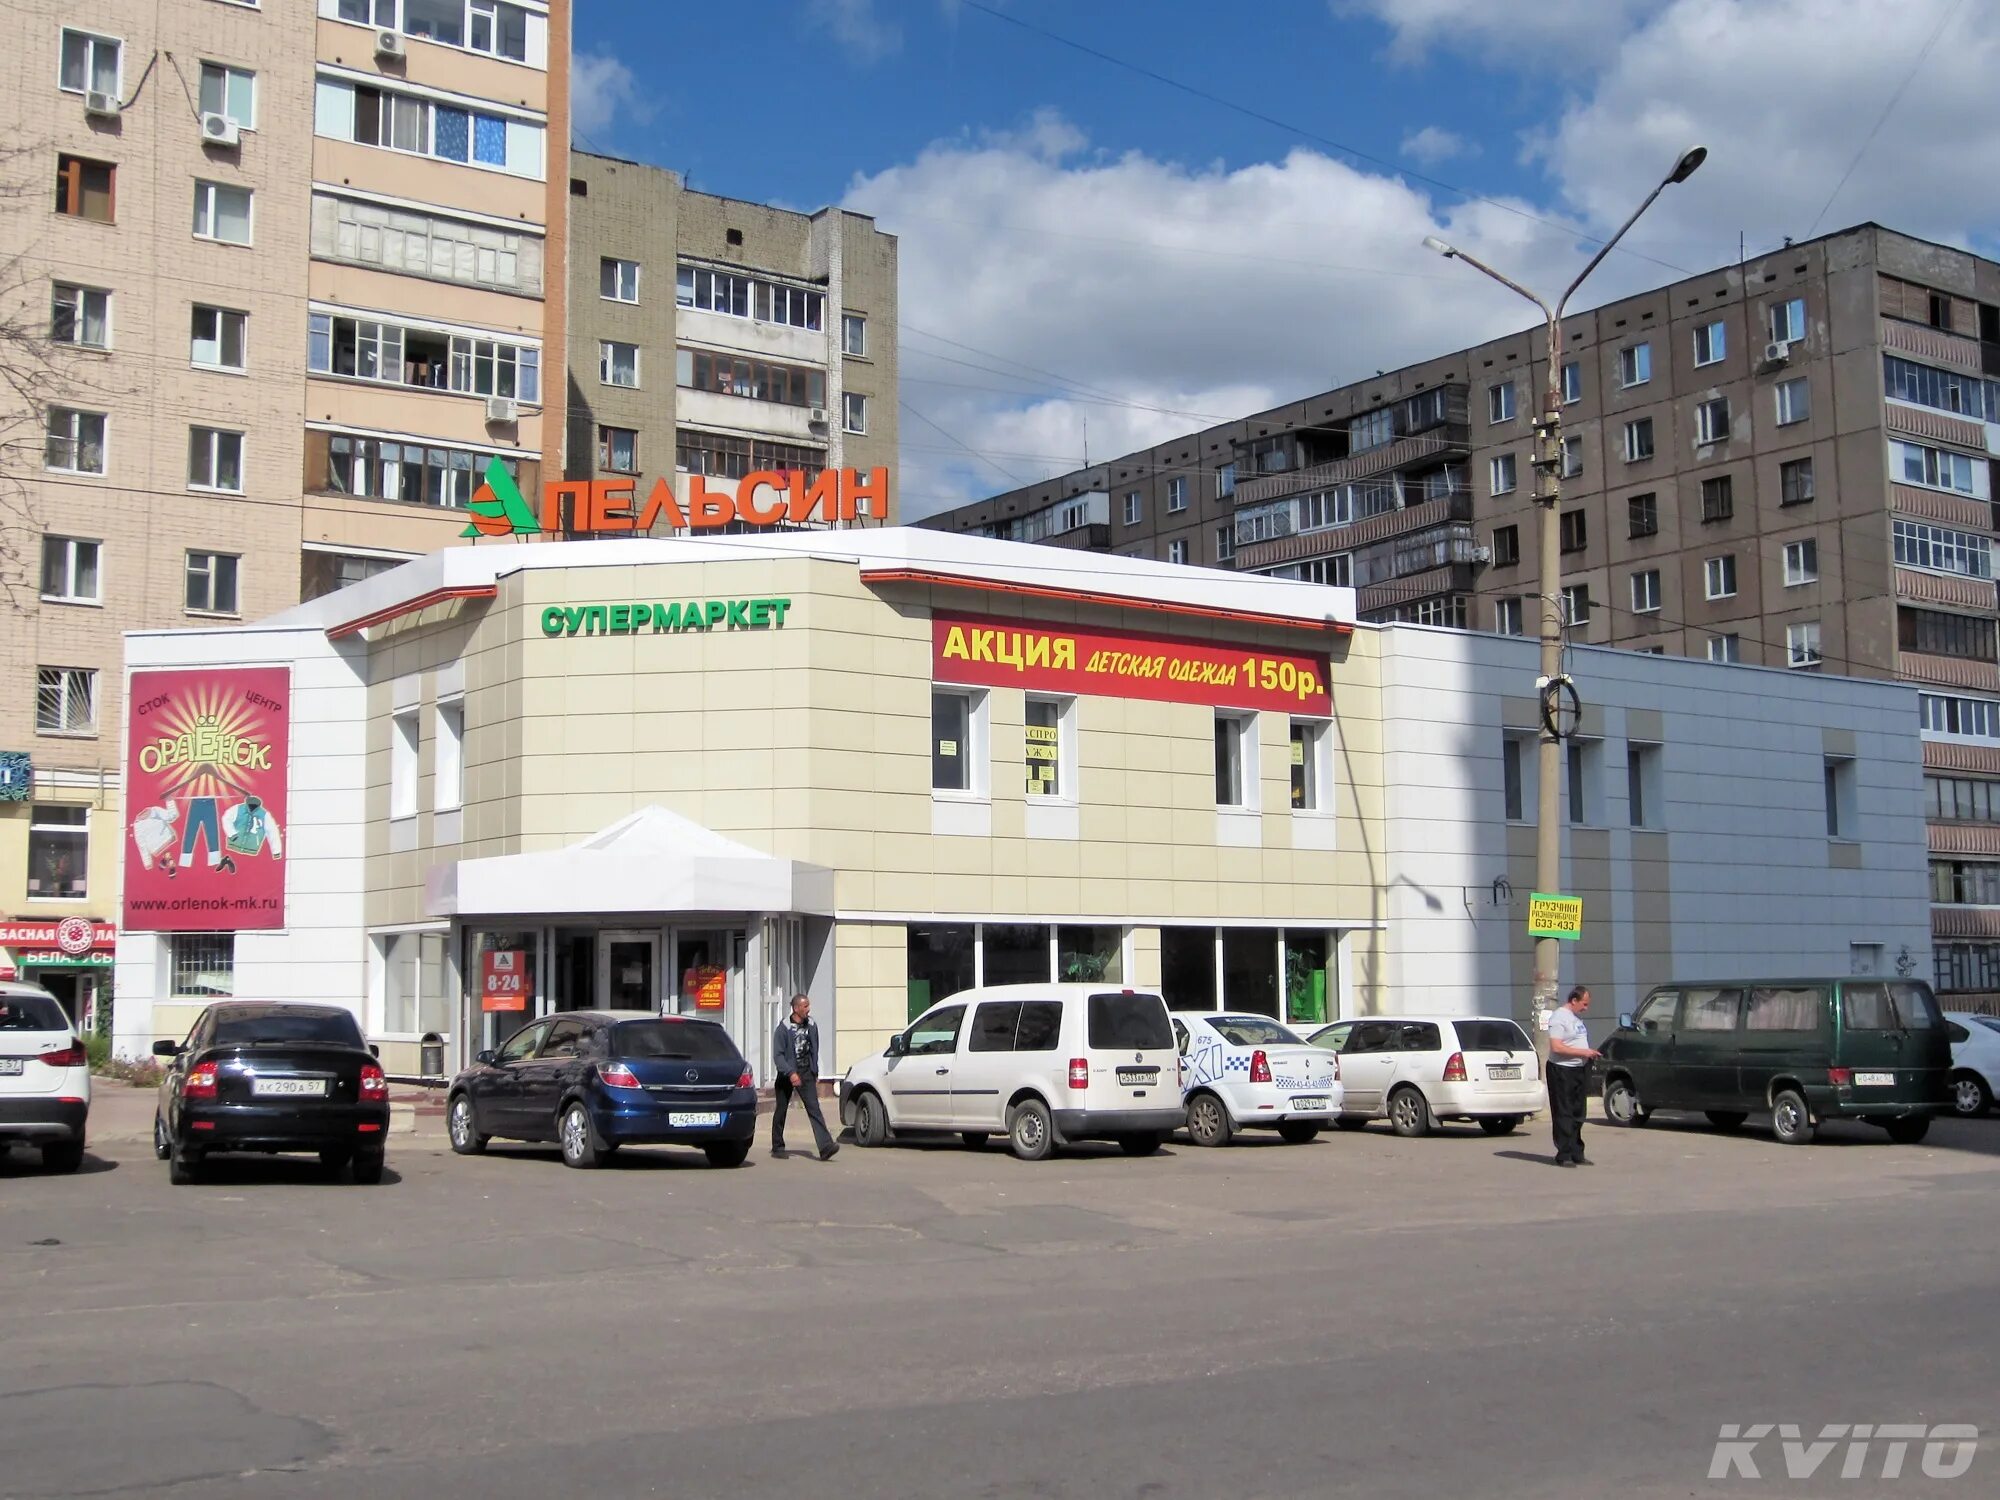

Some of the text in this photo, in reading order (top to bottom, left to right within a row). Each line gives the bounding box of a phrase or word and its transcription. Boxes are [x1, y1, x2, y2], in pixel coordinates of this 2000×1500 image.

[541, 598, 791, 635] СУПЕРМАРКЕТ
[942, 625, 1324, 699] АКЦИЯ ДЕТСКАЯ ОДЕЖДА 150р.
[138, 692, 171, 716] СТОК
[245, 689, 282, 713] ЦЕНТР
[130, 896, 278, 911] www.orlenok-mk.ru
[1534, 900, 1578, 914] ГРУЗЧИКИ
[1535, 918, 1575, 931] 633-433
[1197, 1035, 1212, 1045] 675
